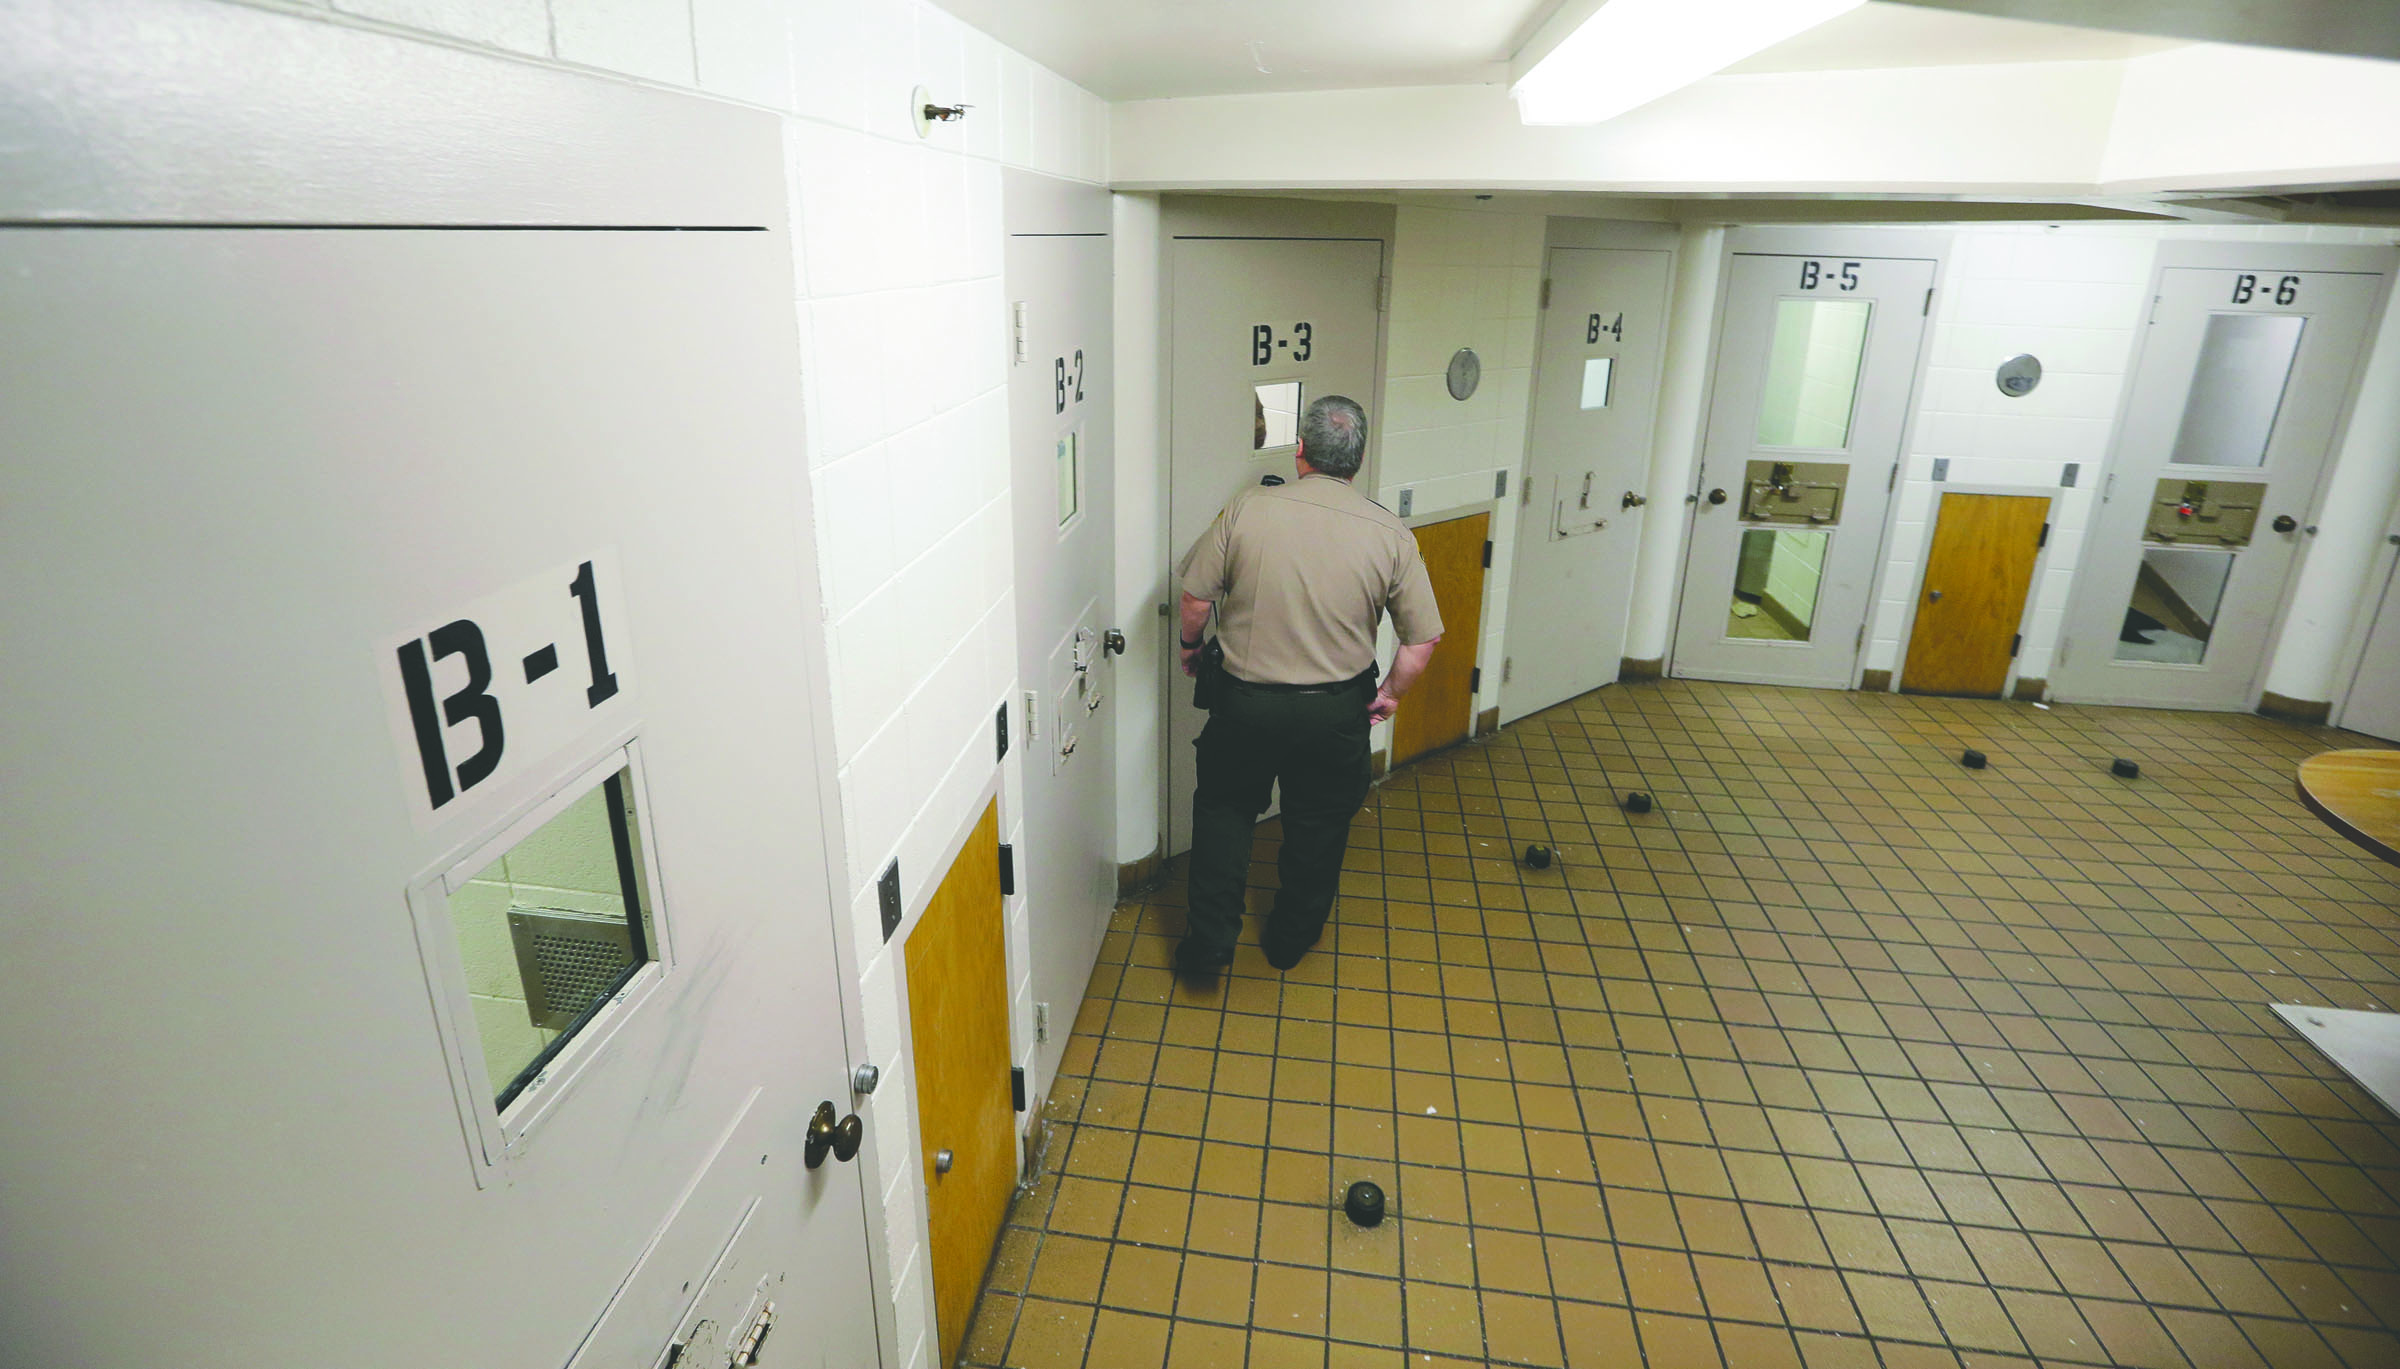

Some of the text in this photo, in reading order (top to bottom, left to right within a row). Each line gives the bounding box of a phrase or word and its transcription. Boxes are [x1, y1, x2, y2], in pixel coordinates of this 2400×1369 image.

[1800, 261, 1861, 291] B-5
[2231, 273, 2301, 306] B-6
[1252, 322, 1312, 366] B-3
[1587, 312, 1623, 345] B-4
[1055, 349, 1084, 414] B-2
[397, 560, 619, 810] B-1
